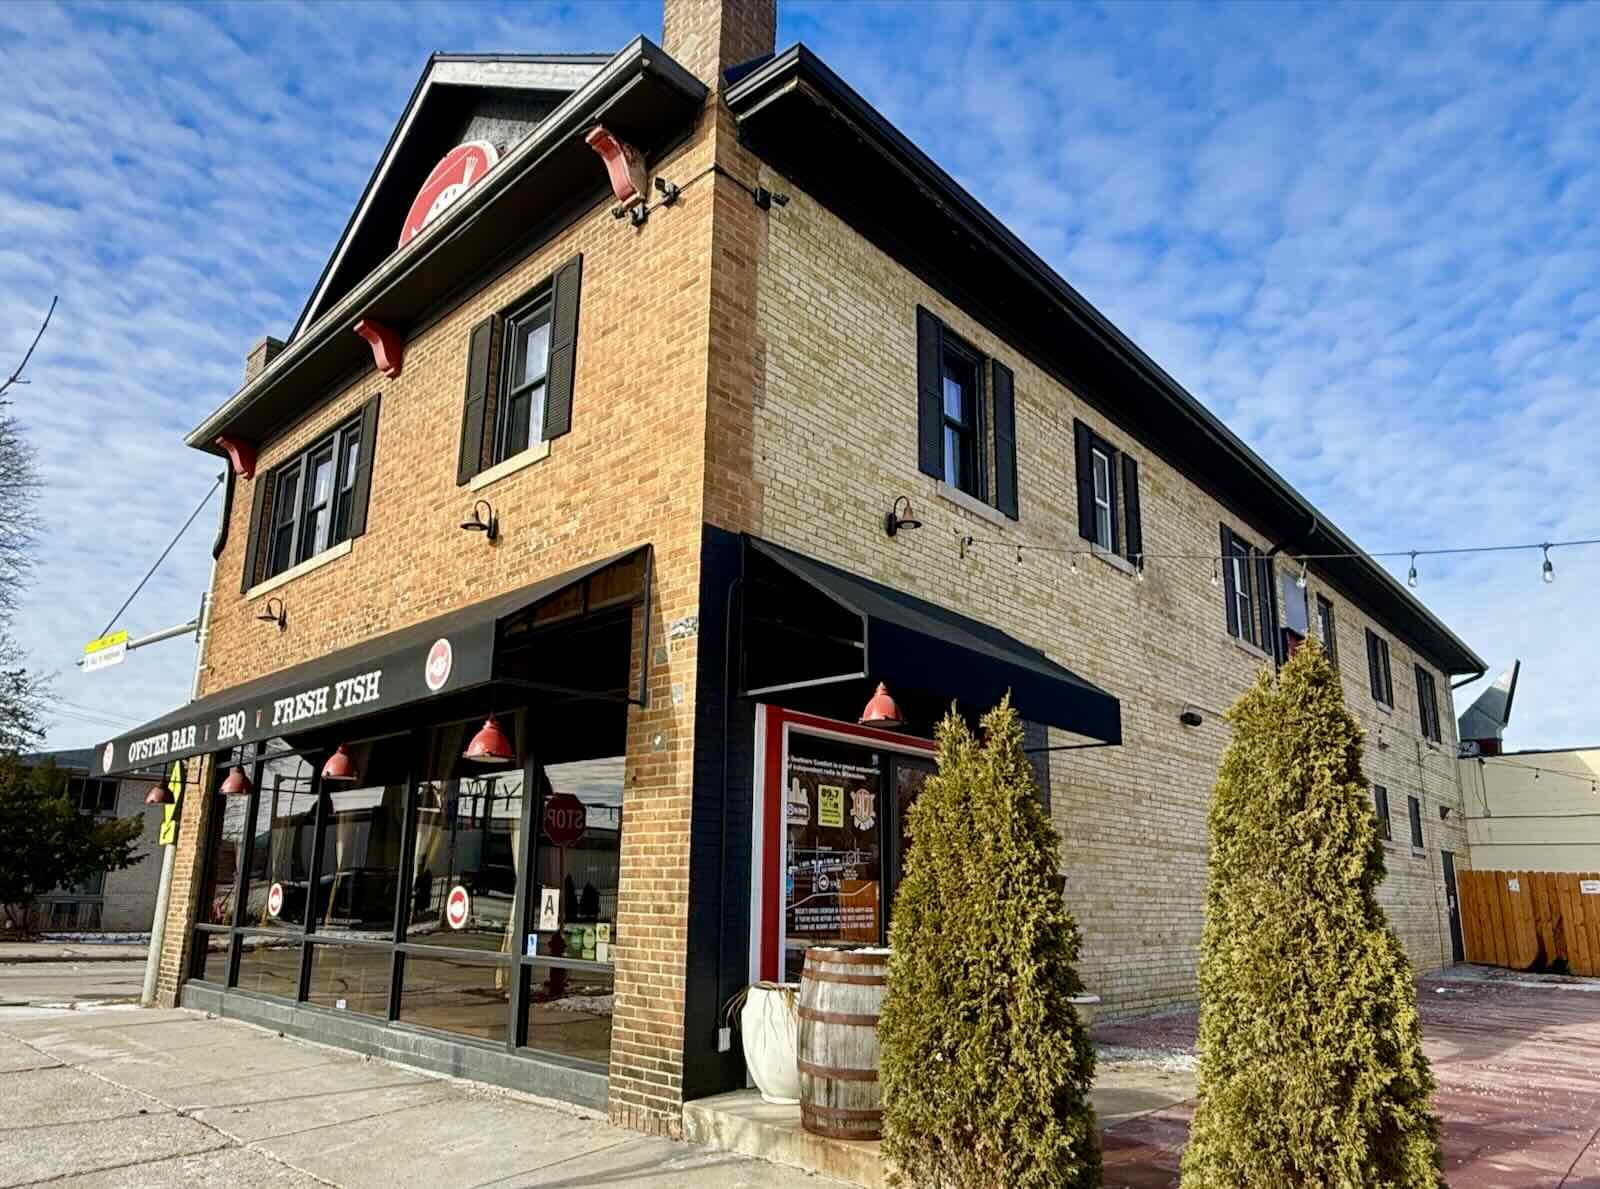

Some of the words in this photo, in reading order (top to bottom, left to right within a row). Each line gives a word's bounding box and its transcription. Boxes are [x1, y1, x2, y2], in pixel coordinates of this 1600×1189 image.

[128, 733, 169, 763] OYSTER
[170, 725, 197, 752] BAR
[217, 710, 246, 740] BBQ
[272, 686, 330, 726] FRESH
[332, 670, 382, 711] FISH
[544, 895, 554, 916] A
